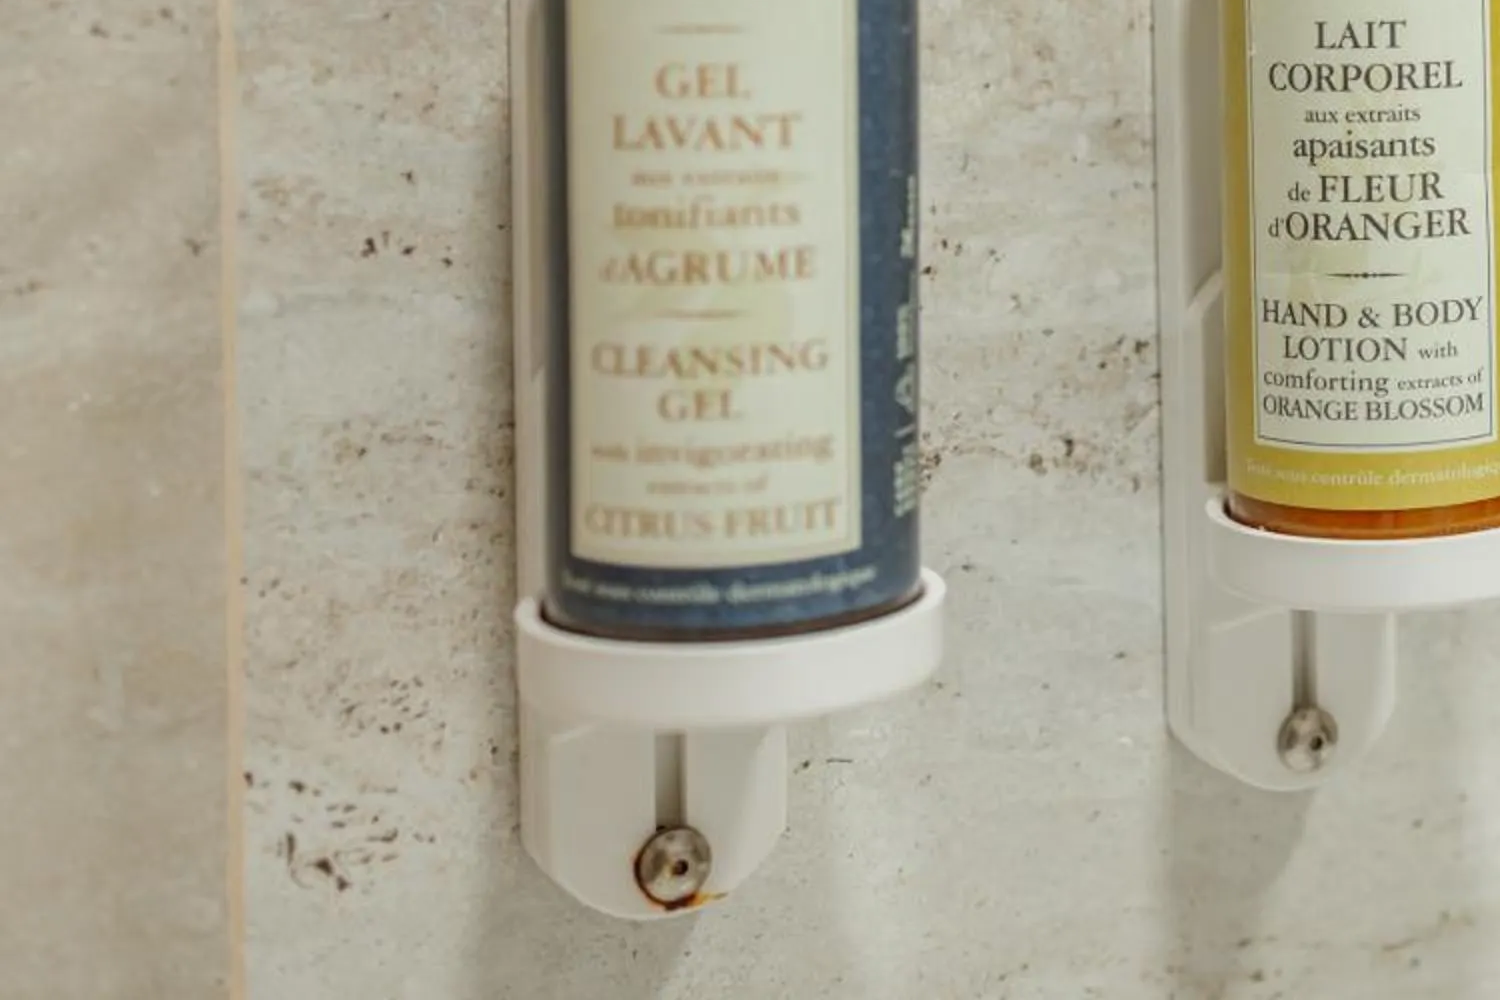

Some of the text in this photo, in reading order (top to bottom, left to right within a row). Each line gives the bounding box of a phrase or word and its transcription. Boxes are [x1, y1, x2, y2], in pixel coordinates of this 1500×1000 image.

[1314, 19, 1407, 50] LAIT
[653, 61, 751, 101] GEL
[1268, 61, 1464, 93] CORPOREL
[1303, 103, 1422, 124] aux extraits
[611, 112, 803, 152] LAVANT
[1292, 130, 1436, 165] apaisants
[1287, 171, 1445, 204] de FLEUR
[1267, 207, 1472, 242] d'ORANGER
[1261, 296, 1484, 329] HAND & BODY
[590, 337, 830, 380] CLEANSING
[1283, 335, 1459, 363] LOTION with
[1263, 368, 1484, 397] comforting extracts of
[656, 388, 744, 423] GEL
[1262, 392, 1484, 422] ORANGE BLOSSOM
